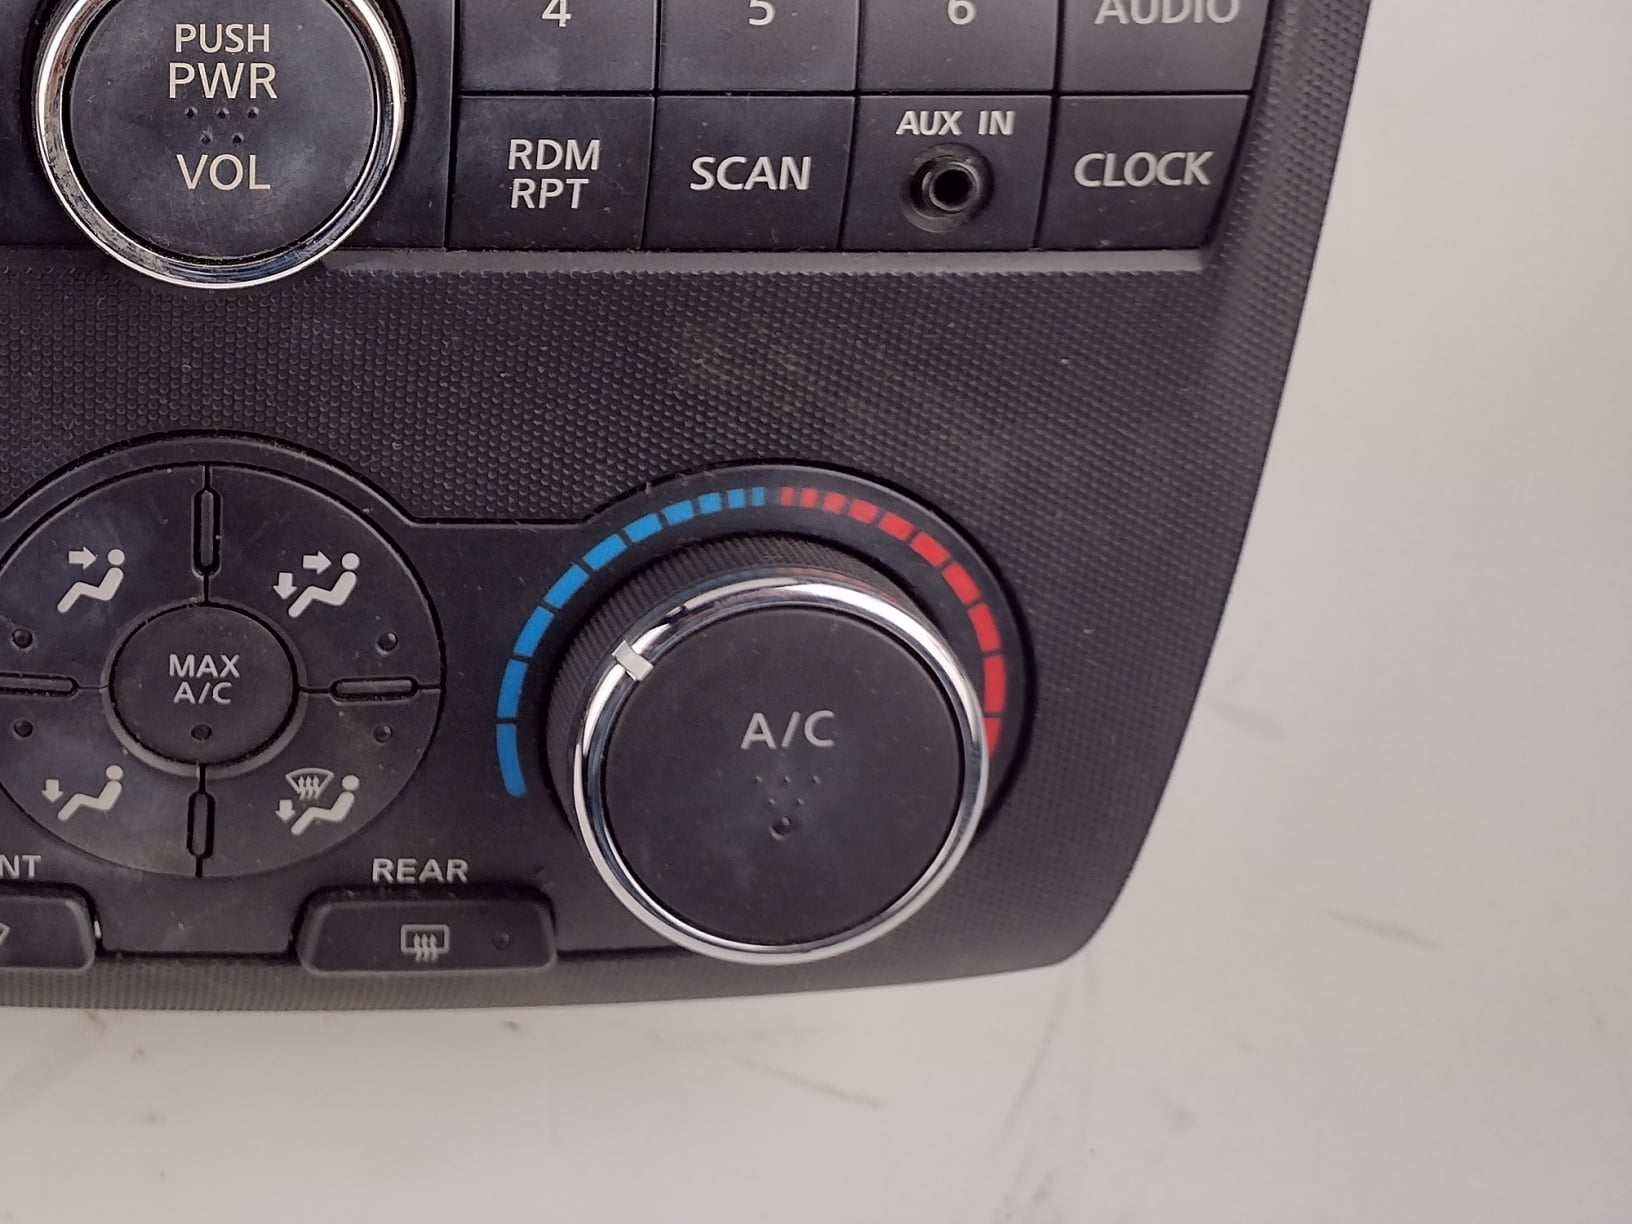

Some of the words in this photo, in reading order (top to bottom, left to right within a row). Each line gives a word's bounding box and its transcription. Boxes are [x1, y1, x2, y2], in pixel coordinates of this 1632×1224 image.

[174, 23, 270, 53] PUSH
[168, 62, 278, 99] PWR
[896, 110, 960, 137] AUX
[979, 111, 1014, 137] IN
[507, 139, 600, 171] RDM
[1074, 152, 1212, 187] CLOCK
[176, 154, 270, 190] VOL
[689, 156, 811, 191] SCAN
[510, 178, 590, 209] RPT
[169, 653, 240, 677] MAX
[173, 682, 232, 705] A/C
[741, 709, 835, 750] A/C
[372, 857, 468, 883] REAR
